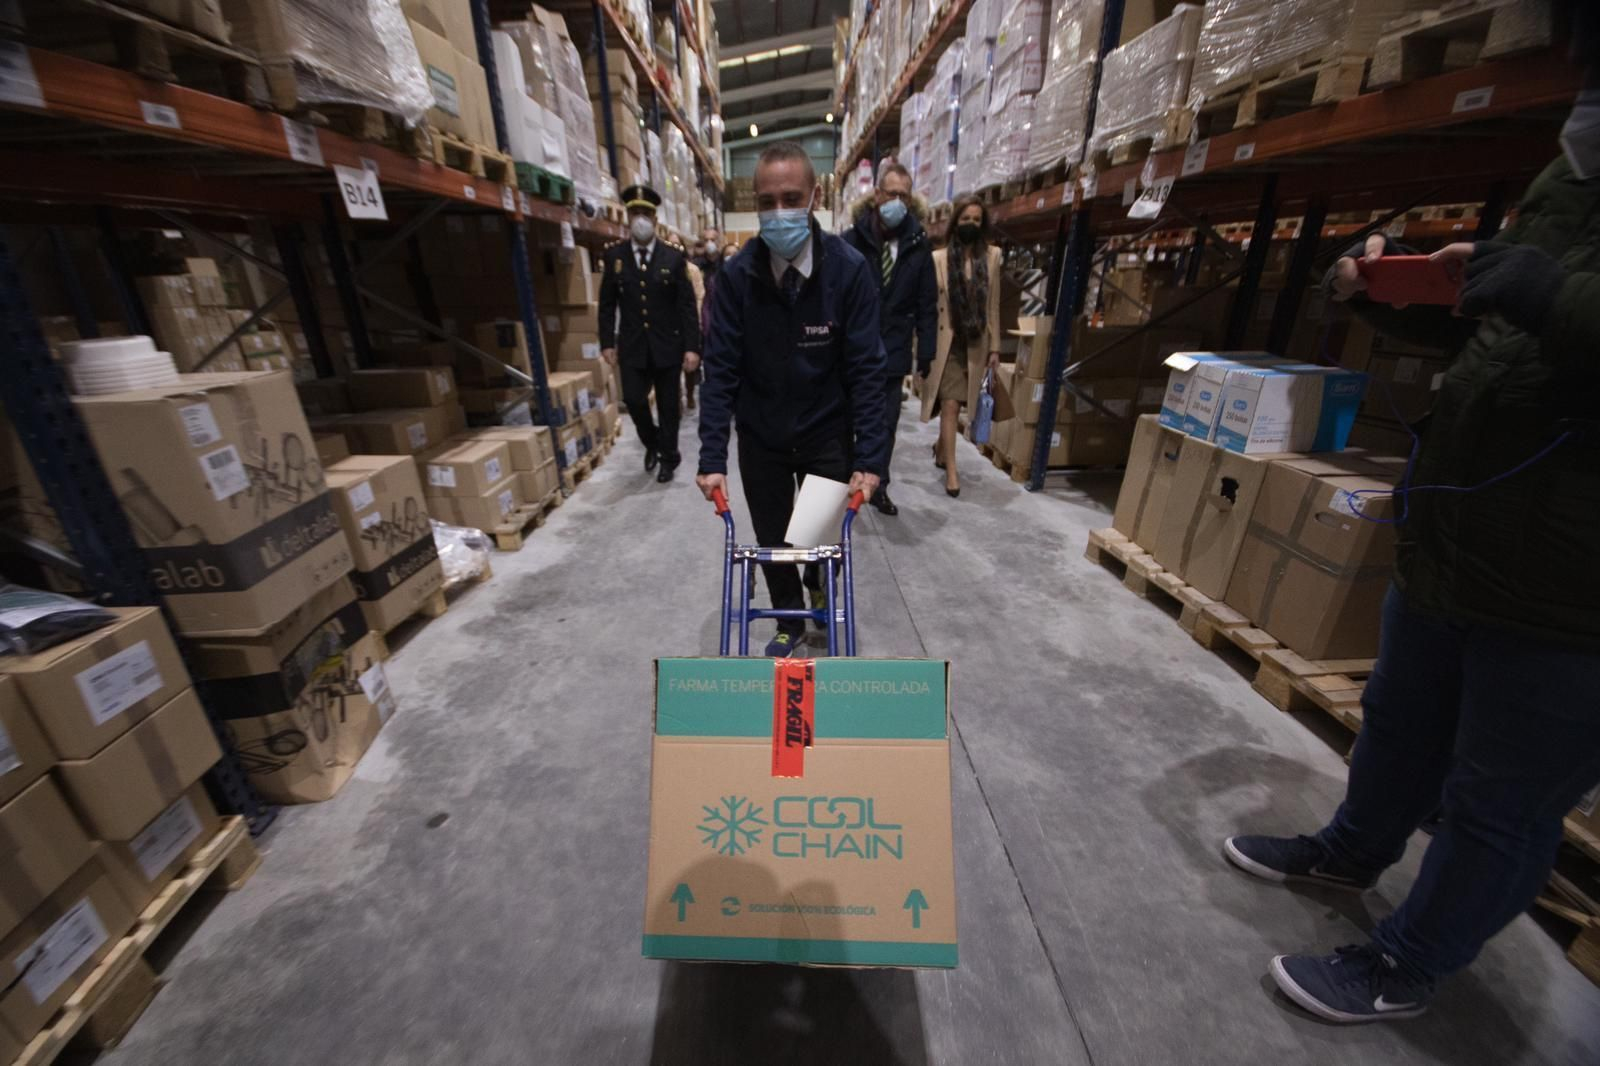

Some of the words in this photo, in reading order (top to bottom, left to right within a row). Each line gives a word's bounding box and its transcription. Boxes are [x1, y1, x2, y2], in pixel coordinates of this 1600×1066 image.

[343, 182, 378, 208] B14
[804, 325, 830, 336] TIPSA
[151, 558, 225, 590] alab
[669, 678, 718, 693] FARMA
[831, 680, 930, 694] CONTROLADA
[773, 796, 902, 830] COOL
[772, 832, 902, 859] CHAIN
